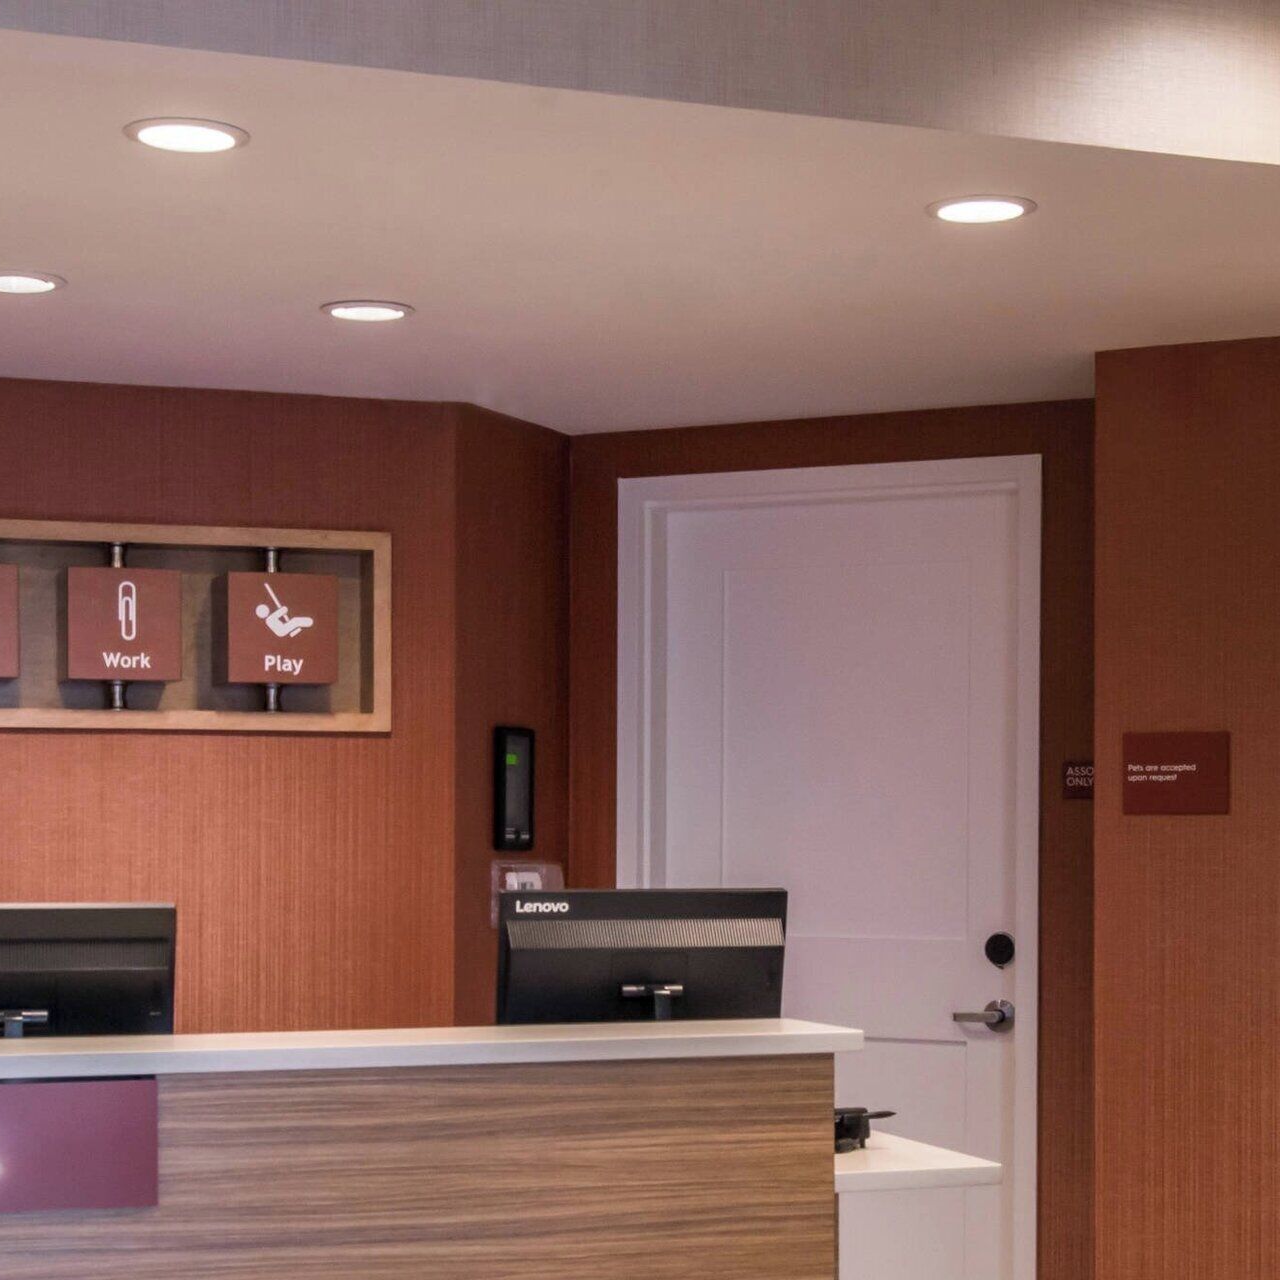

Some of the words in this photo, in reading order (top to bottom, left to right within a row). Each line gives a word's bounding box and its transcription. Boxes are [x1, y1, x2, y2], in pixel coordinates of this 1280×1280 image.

[102, 651, 152, 670] Work
[263, 653, 305, 675] Play
[1127, 763, 1144, 772] Pets
[1160, 763, 1197, 773] accepted
[1066, 777, 1094, 787] ONLY
[1127, 774, 1148, 782] upon
[1149, 773, 1178, 782] request
[515, 899, 570, 914] Lenovo
